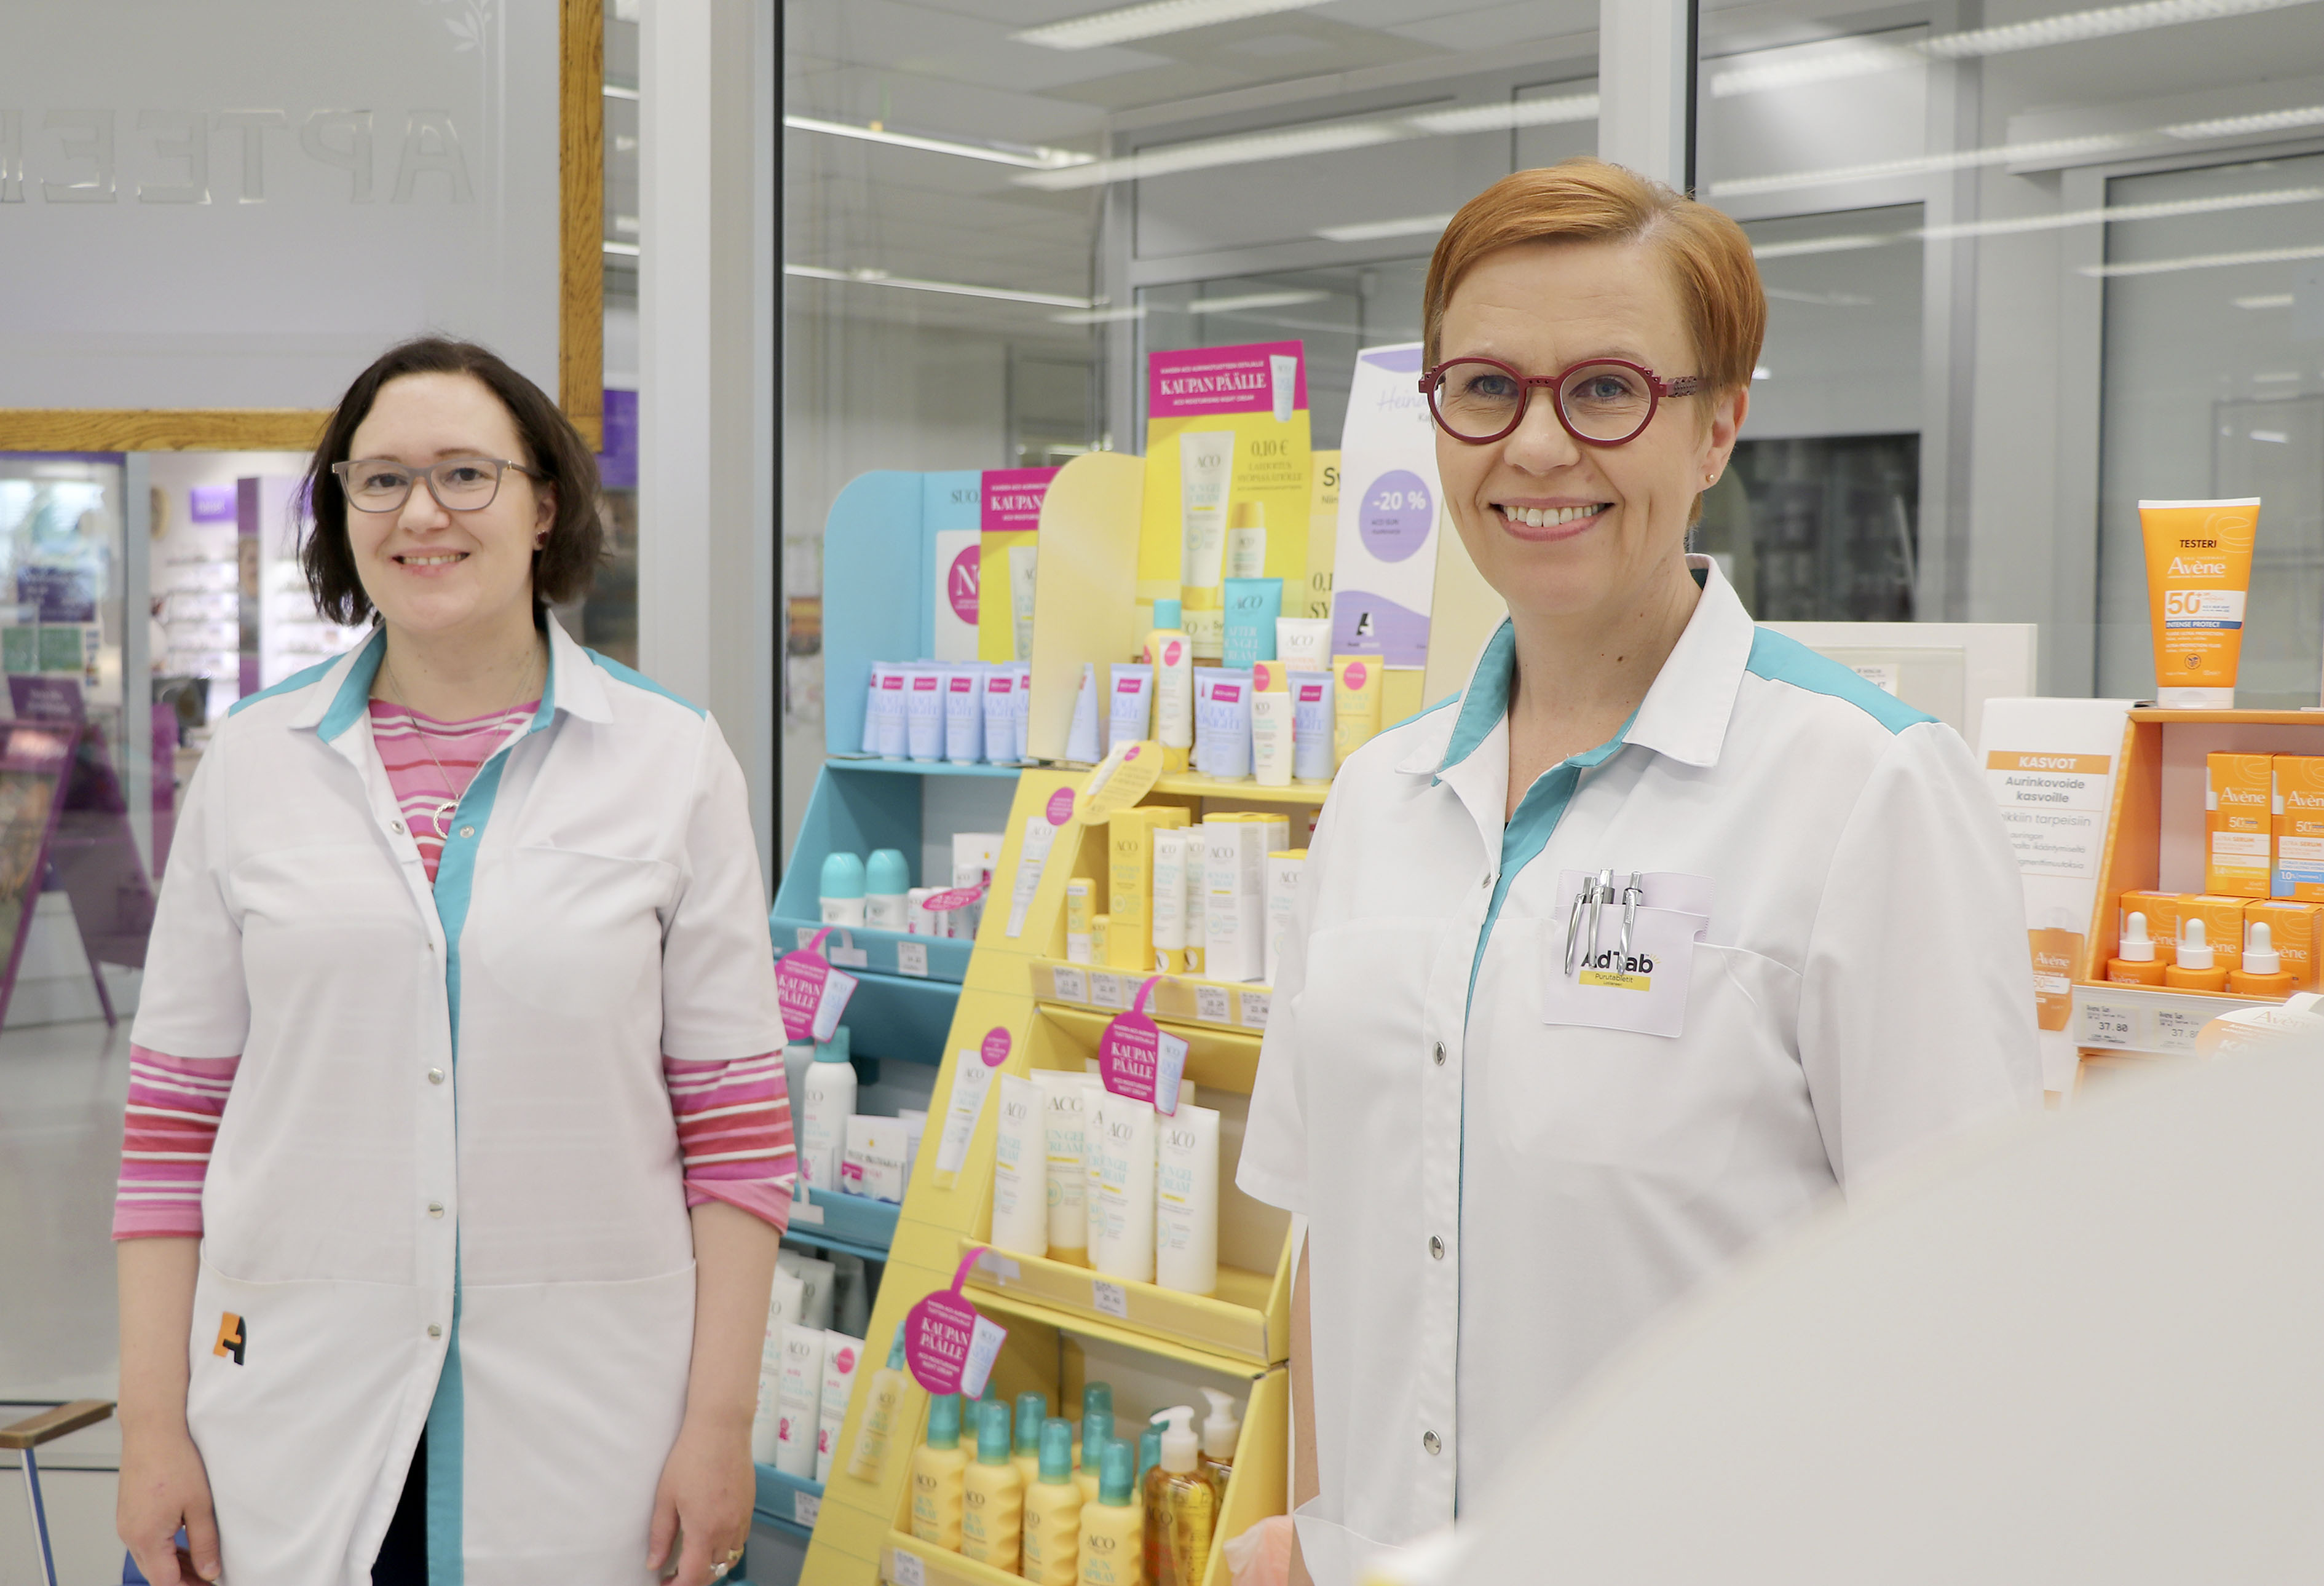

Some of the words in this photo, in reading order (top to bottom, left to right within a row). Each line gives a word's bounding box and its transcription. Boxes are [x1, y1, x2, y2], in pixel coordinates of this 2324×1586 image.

[1160, 376, 1215, 396] KAUPAN
[1216, 372, 1267, 392] PÄÄLLE
[1195, 454, 1221, 469] ACO
[951, 490, 981, 505] SUO
[990, 493, 1043, 511] KAUPAN
[1372, 491, 1403, 511] -20
[1407, 490, 1427, 510] %
[2180, 539, 2218, 548] TESTERI
[2167, 556, 2226, 575] Avène
[1231, 594, 1263, 611] ACO
[1286, 635, 1314, 647] ACO
[2018, 756, 2077, 770] KASVOT
[2005, 776, 2085, 789] Aurinkovoide
[2015, 791, 2069, 803] kasvoille
[2220, 786, 2266, 803] Avène
[2036, 814, 2092, 827] tarpeisiin
[1116, 840, 1139, 851] ACO
[1209, 846, 1234, 859] ACO
[2017, 858, 2085, 870] igmenttimuutoksia
[2152, 933, 2177, 946] ène
[2211, 941, 2237, 954] ène
[2279, 945, 2308, 960] ène
[2034, 952, 2071, 967] Avène
[1595, 973, 1634, 984] Purutabletit
[2098, 1021, 2128, 1033] 37.80
[1112, 1041, 1156, 1065] KAUPAN
[1112, 1056, 1154, 1079] PÄÄLLE
[805, 1090, 824, 1102] CO
[1004, 1102, 1026, 1119] ACO
[1107, 1122, 1133, 1140] ACO
[1166, 1130, 1195, 1150] ACO
[921, 1316, 971, 1346] KAUPAN
[787, 1341, 810, 1357] ACO
[920, 1332, 965, 1360] PÄÄLLE
[915, 1473, 937, 1489] ACO
[965, 1489, 986, 1506] ACO
[1087, 1534, 1116, 1550] ACO
